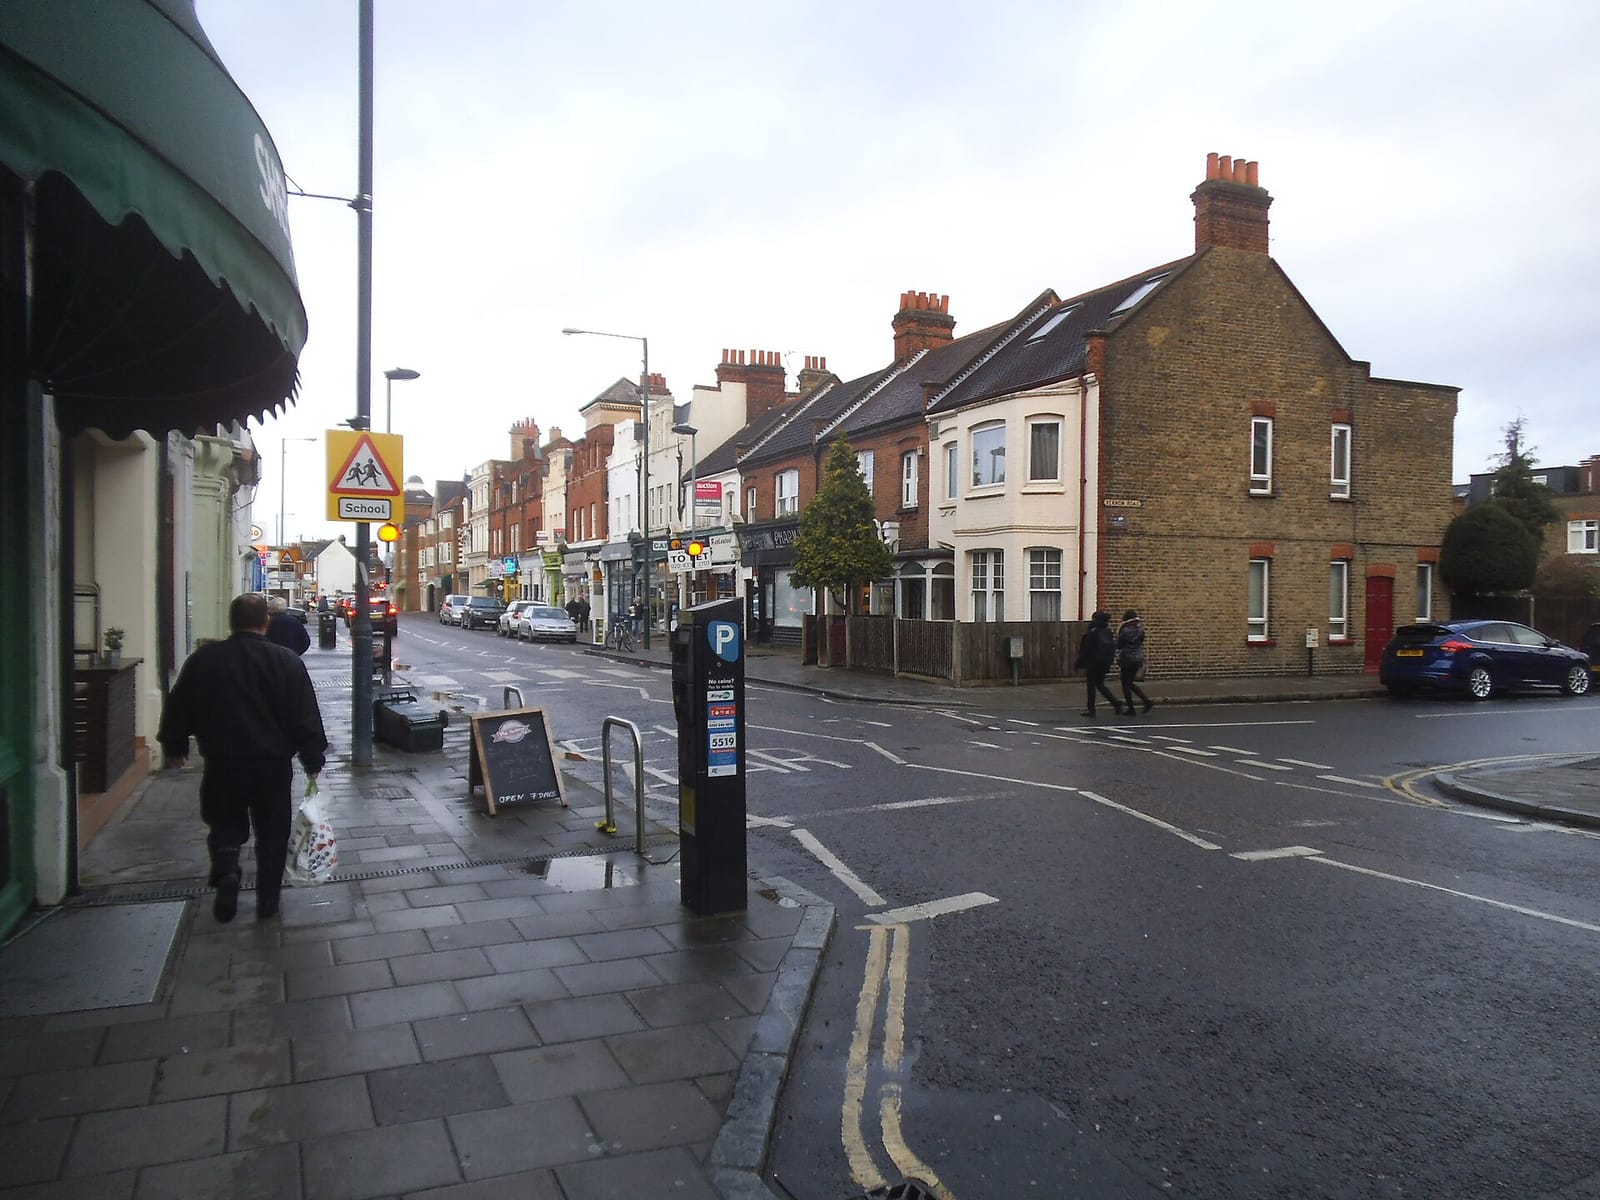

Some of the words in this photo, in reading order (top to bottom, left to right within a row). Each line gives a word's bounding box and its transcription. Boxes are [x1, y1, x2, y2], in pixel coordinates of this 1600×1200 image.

[344, 502, 386, 514] School
[670, 554, 686, 563] TO
[716, 624, 735, 655] P
[712, 737, 735, 747] 5519
[499, 793, 524, 804] OPEN
[530, 792, 537, 800] 7
